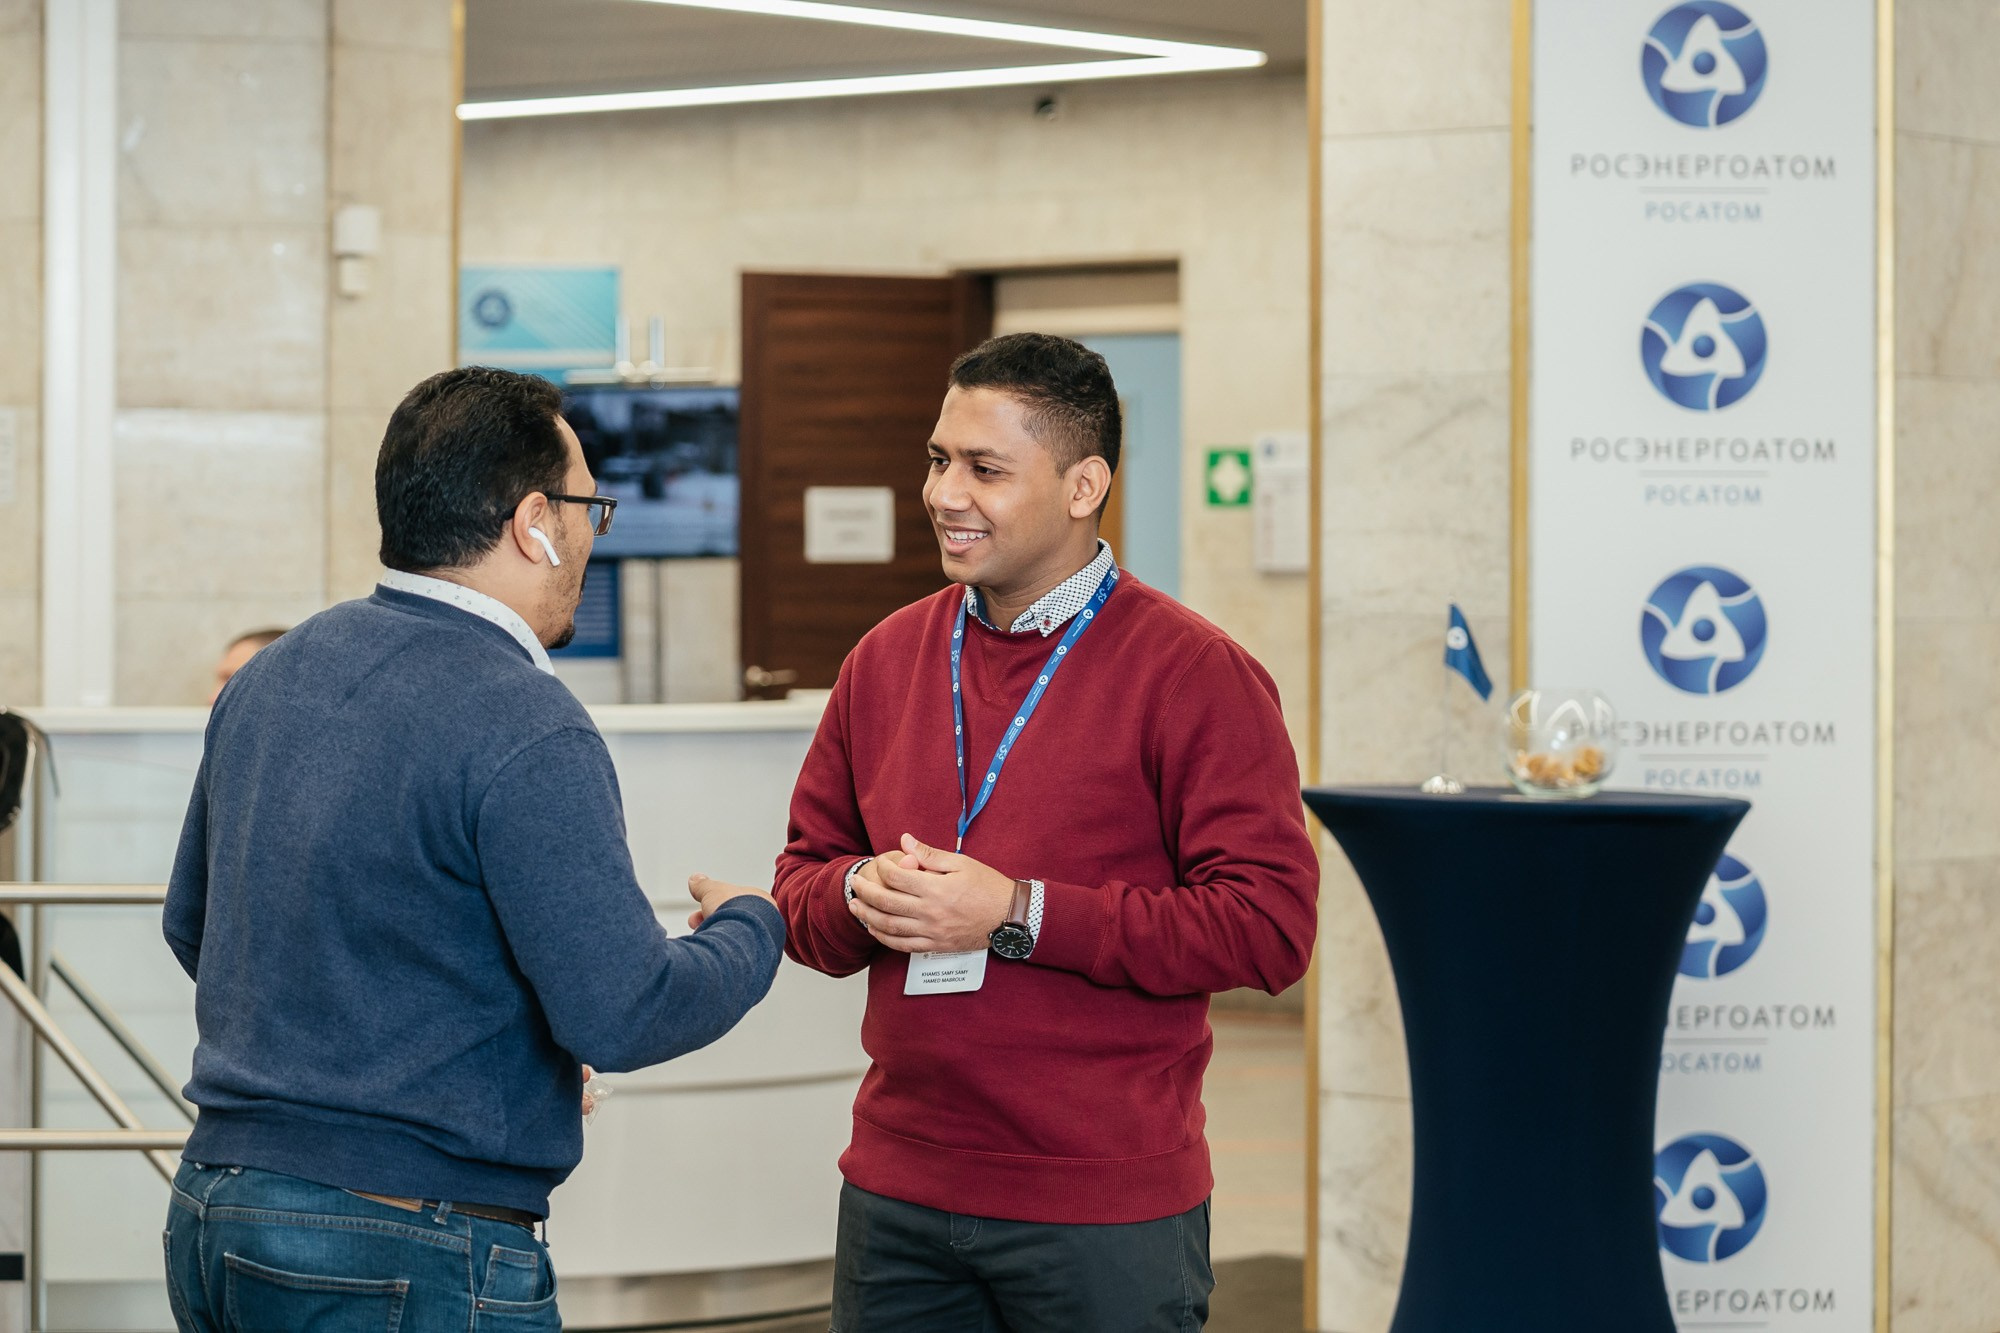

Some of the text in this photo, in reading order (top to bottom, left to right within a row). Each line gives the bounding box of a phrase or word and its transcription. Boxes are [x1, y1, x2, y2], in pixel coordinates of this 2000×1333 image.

[1570, 153, 1837, 179] РОСЭНЕРГОАТОМ
[1645, 201, 1763, 222] РОСАТОМ
[1570, 436, 1837, 462] РОСЭНЕРГОАТОМ
[1645, 484, 1763, 505] РОСАТОМ
[1645, 768, 1763, 788] РОСАТОМ
[1676, 1004, 1837, 1030] ЕРГОАТОМ
[1661, 1052, 1763, 1073] ОСАТОМ
[1676, 1288, 1837, 1314] ЕРГОАТОМ
